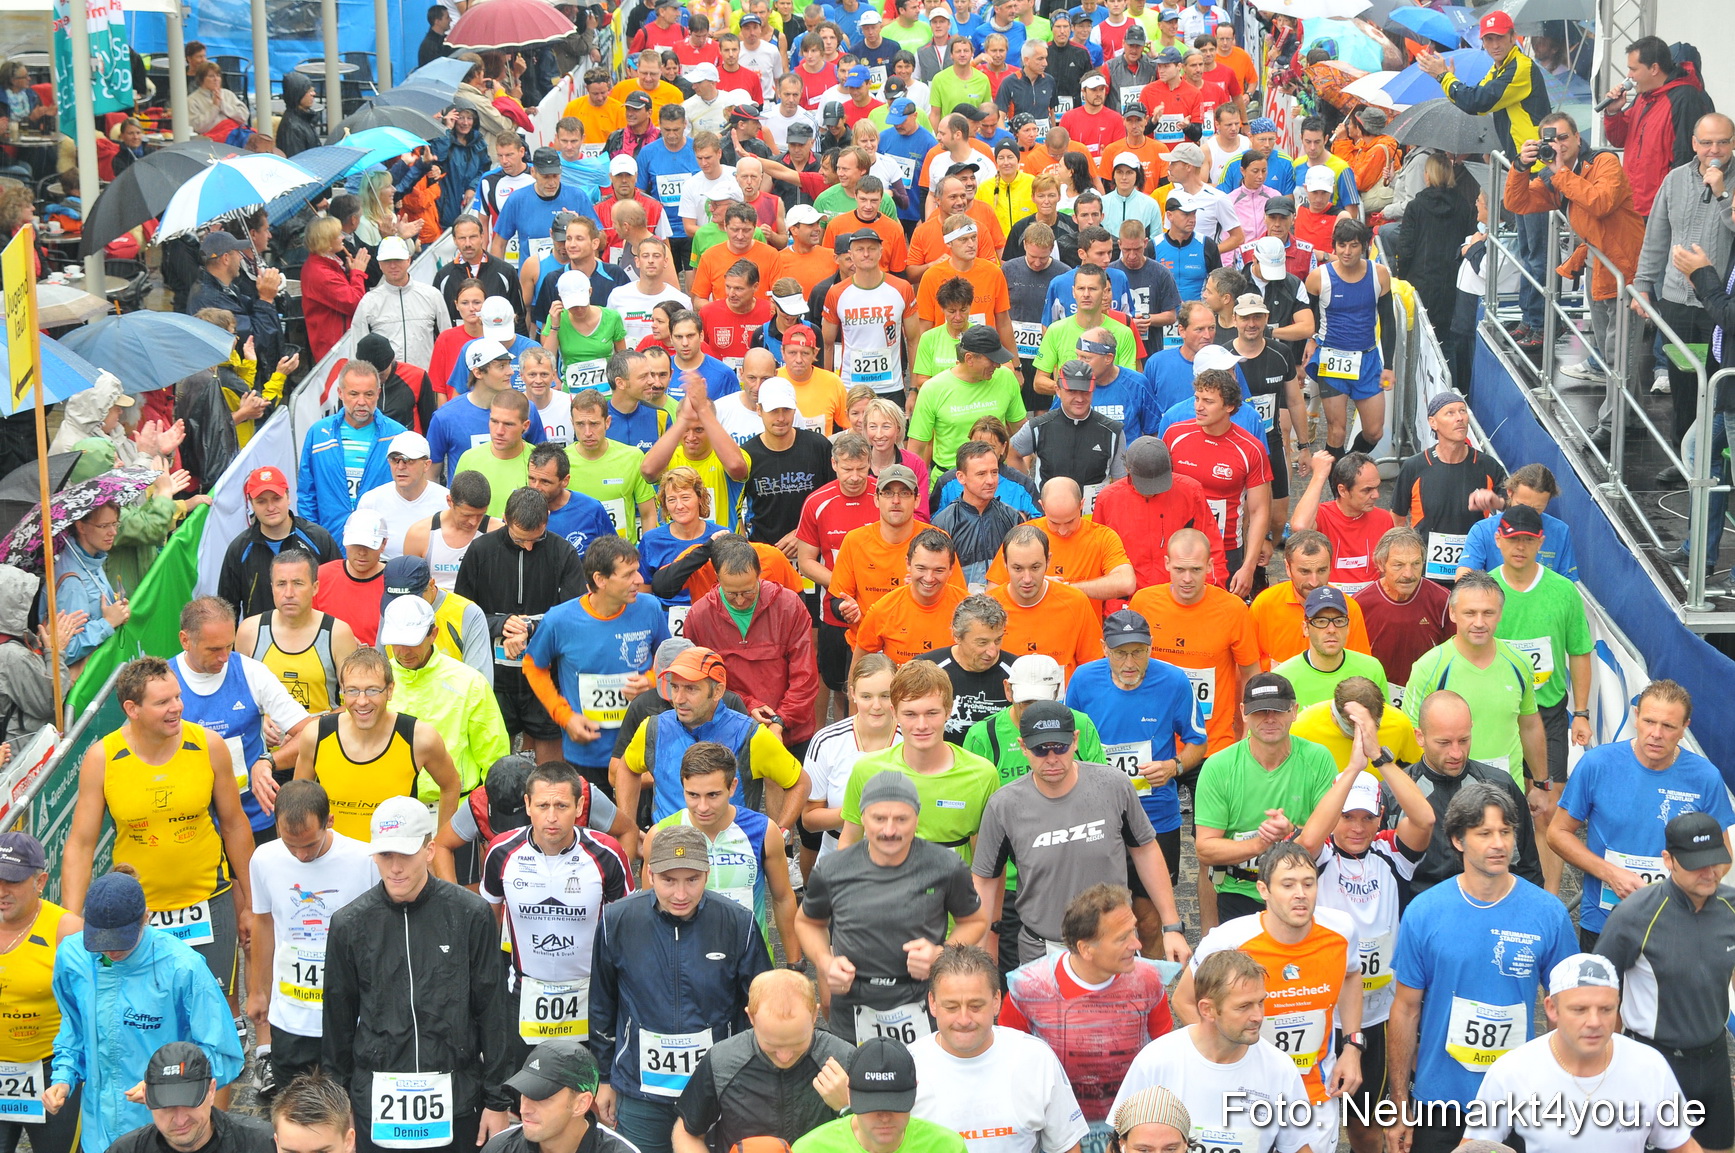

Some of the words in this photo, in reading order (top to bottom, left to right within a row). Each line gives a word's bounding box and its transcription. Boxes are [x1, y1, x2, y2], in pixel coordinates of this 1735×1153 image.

[844, 305, 895, 320] MERZ
[855, 357, 888, 373] 3218
[1328, 357, 1352, 373] 813
[571, 368, 606, 387] 2277
[519, 904, 587, 916] WOLFRUM
[1499, 936, 1534, 945] STADTLAUF
[1501, 930, 1541, 942] NEUMARKTER
[535, 996, 578, 1021] 604
[124, 1020, 162, 1030] racing
[539, 1026, 573, 1035] Werner
[1275, 1029, 1306, 1053] 87
[1465, 1019, 1513, 1049] 587
[1473, 1052, 1497, 1064] Arno
[380, 1093, 445, 1122] 2105
[393, 1126, 430, 1139] Dennis
